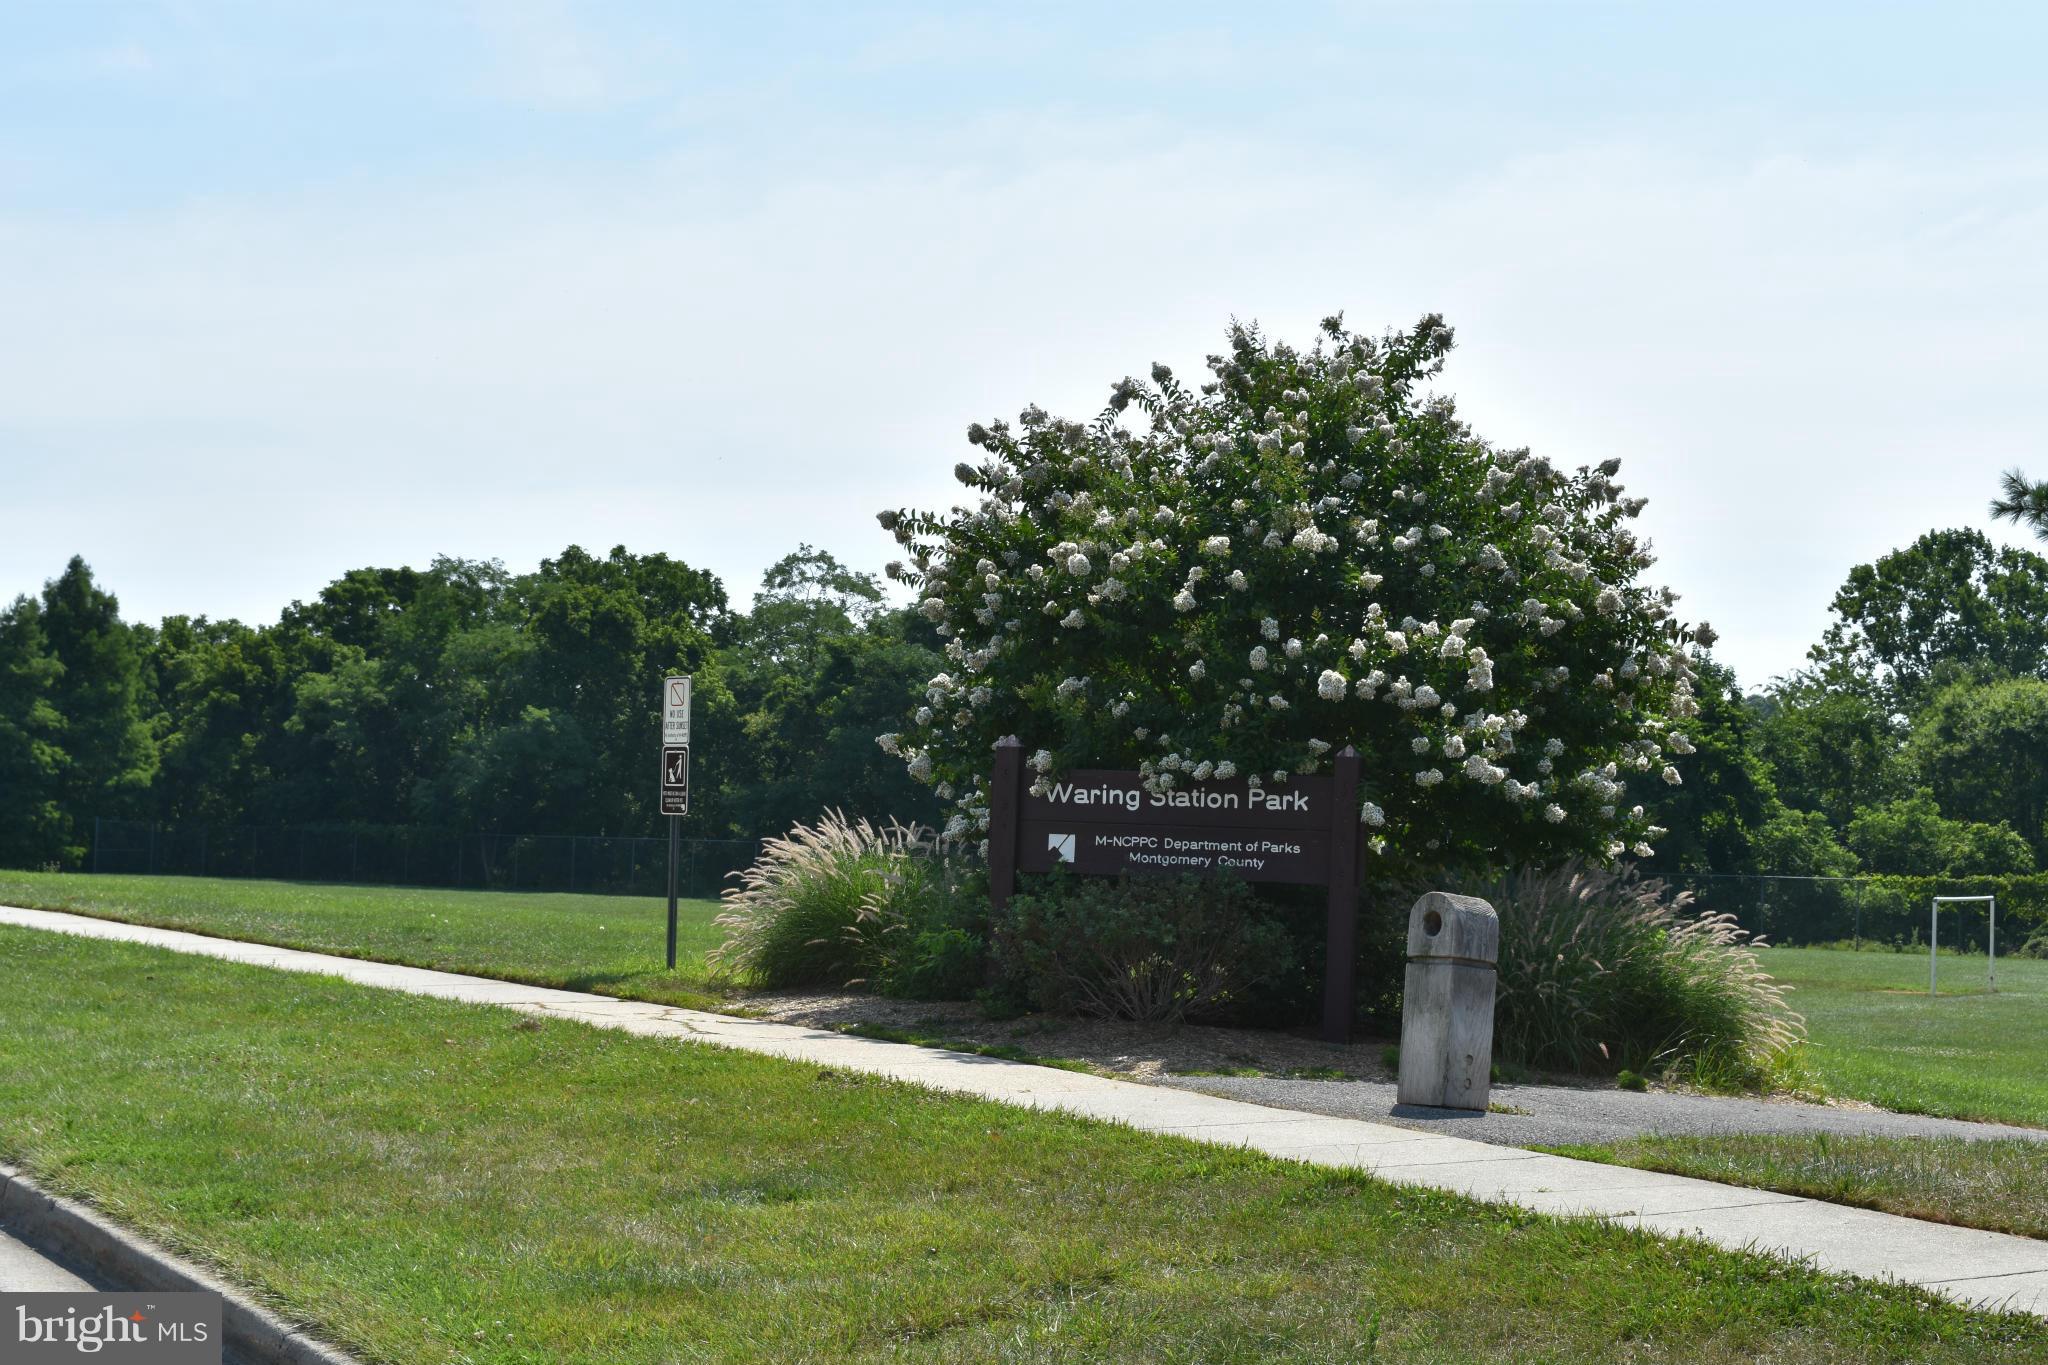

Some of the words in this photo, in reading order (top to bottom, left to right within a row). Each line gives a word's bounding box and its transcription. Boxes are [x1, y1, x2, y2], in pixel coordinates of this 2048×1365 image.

[1047, 783, 1140, 811] Waring
[1150, 787, 1238, 809] Station
[1248, 788, 1309, 811] Park
[1095, 835, 1158, 848] M-NCPPC
[1164, 837, 1241, 852] Department
[1245, 840, 1259, 851] of
[1261, 841, 1301, 854] Parks
[1129, 852, 1211, 867] Montgomery
[1218, 855, 1265, 870] County
